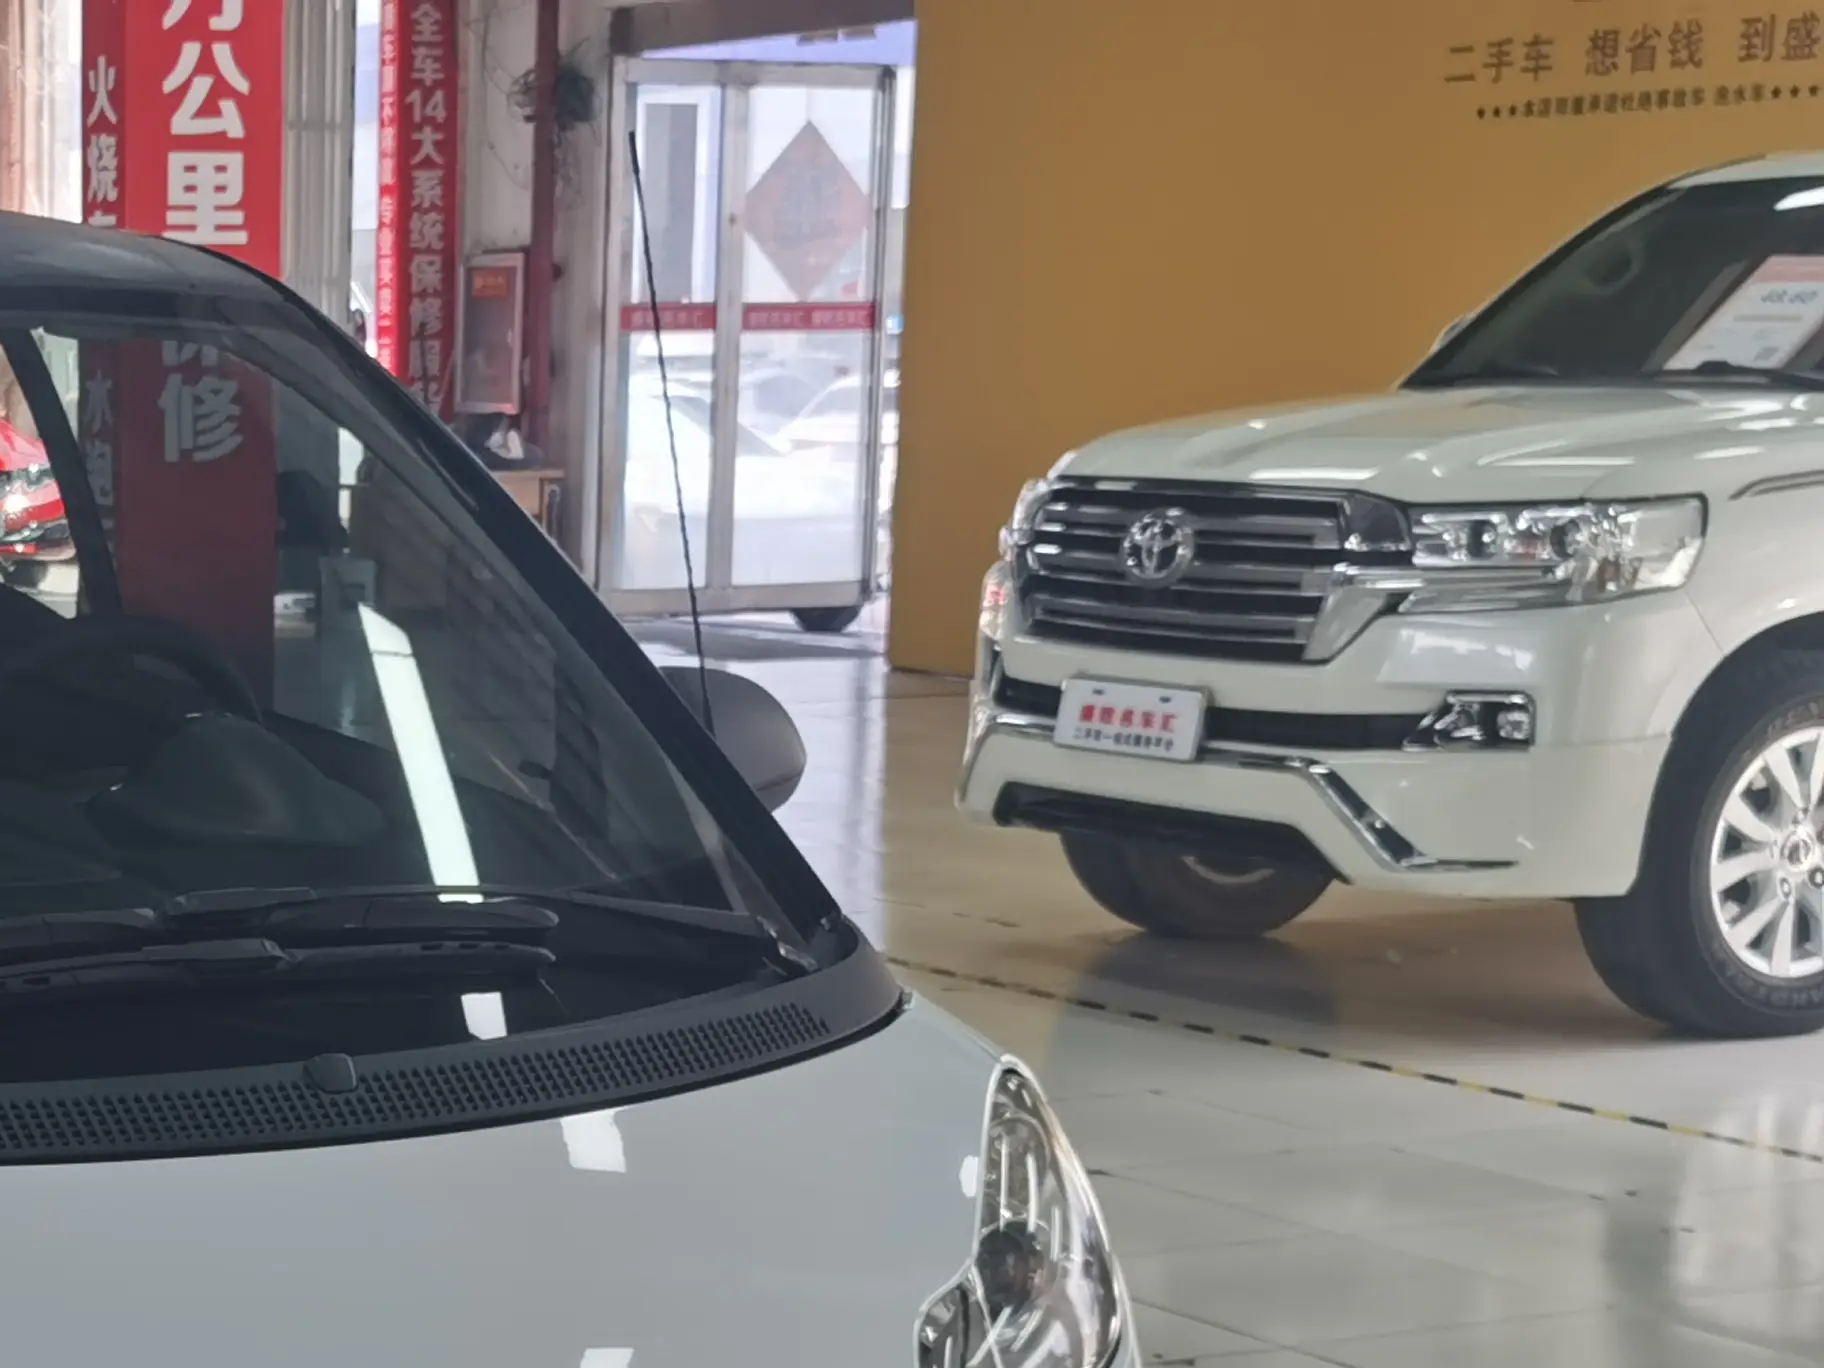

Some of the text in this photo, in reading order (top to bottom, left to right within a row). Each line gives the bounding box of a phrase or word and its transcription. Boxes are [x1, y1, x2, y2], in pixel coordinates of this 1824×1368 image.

[1444, 36, 1554, 84] 二手车
[1584, 20, 1704, 77] 想省钱
